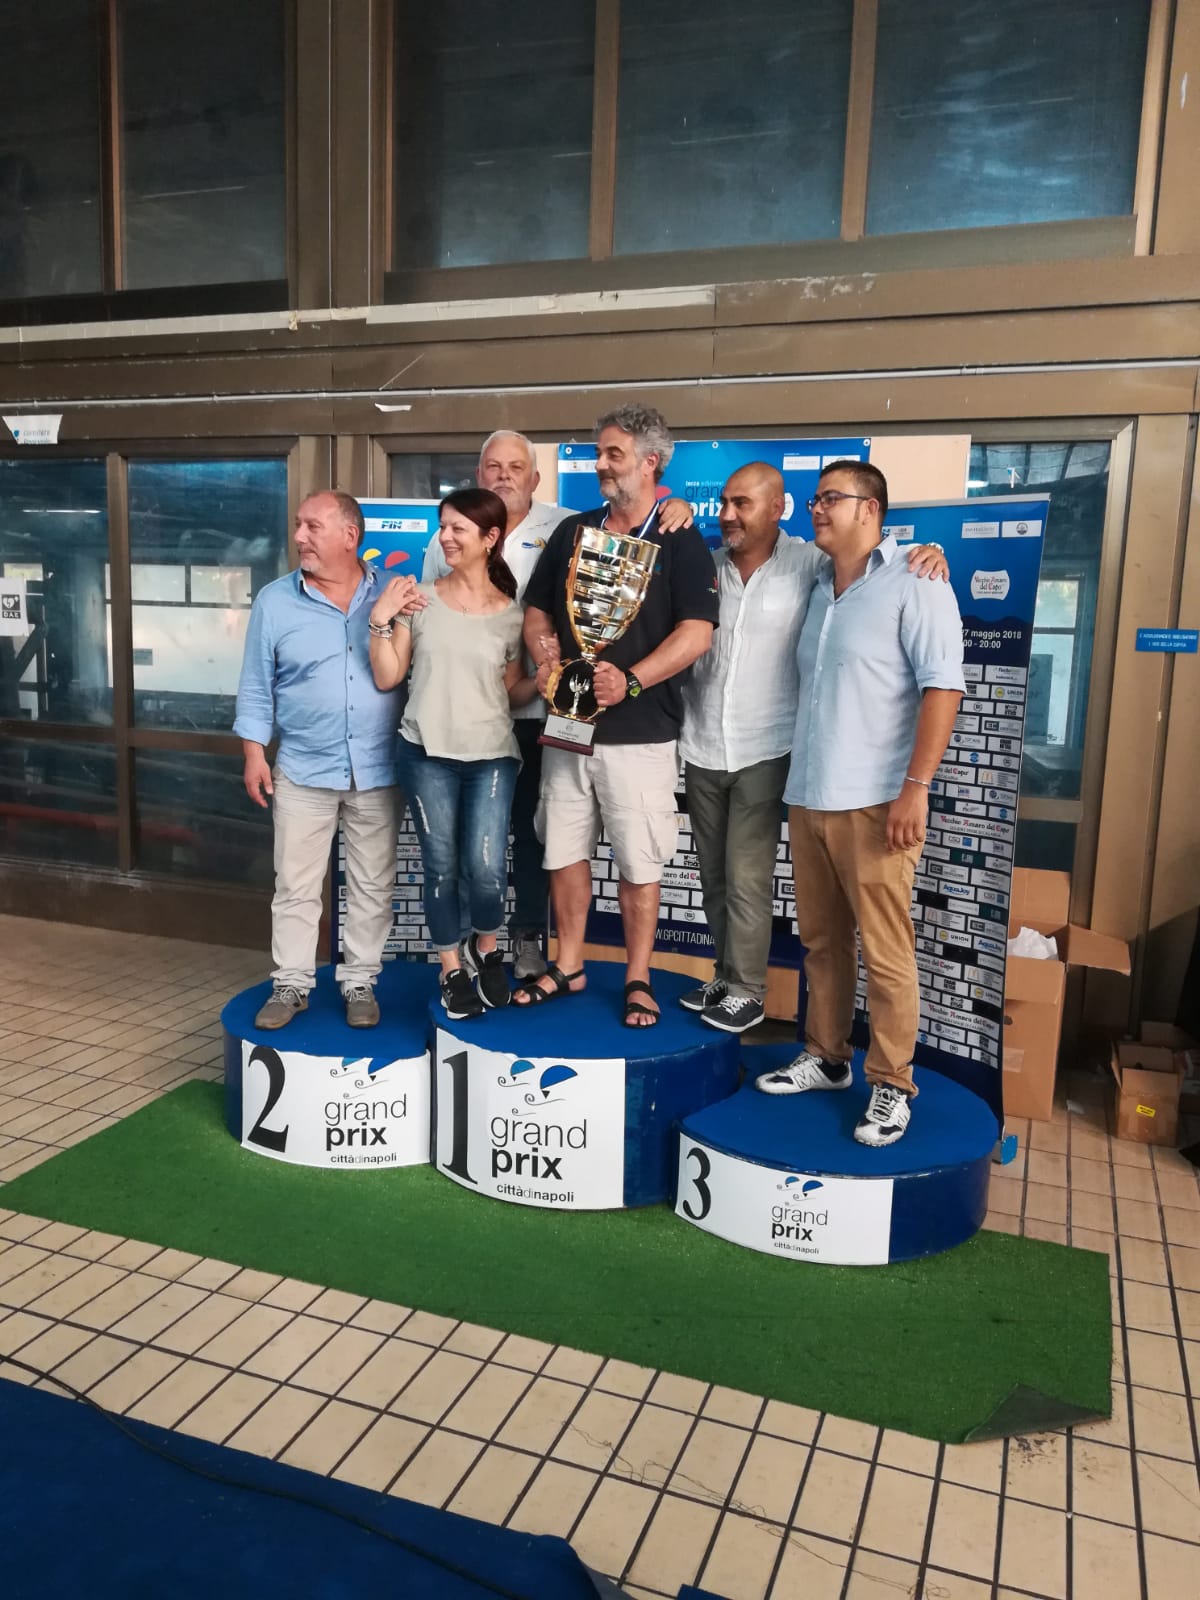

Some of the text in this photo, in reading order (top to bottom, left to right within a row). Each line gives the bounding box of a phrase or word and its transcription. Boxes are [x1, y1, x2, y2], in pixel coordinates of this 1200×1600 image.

[971, 630, 1001, 639] maggio
[1002, 630, 1022, 639] 2018
[979, 640, 1001, 649] 20:00
[940, 815, 961, 825] Vecchio
[963, 819, 985, 829] Amaro
[950, 934, 969, 942] UNION
[248, 1045, 289, 1153] 2
[324, 1093, 407, 1126] grand
[442, 1050, 478, 1185] 1
[325, 1122, 388, 1151] prix
[490, 1116, 587, 1149] grand
[491, 1147, 563, 1180] prix
[682, 1147, 711, 1220] 3
[771, 1205, 828, 1226] grand
[771, 1222, 814, 1242] prix
